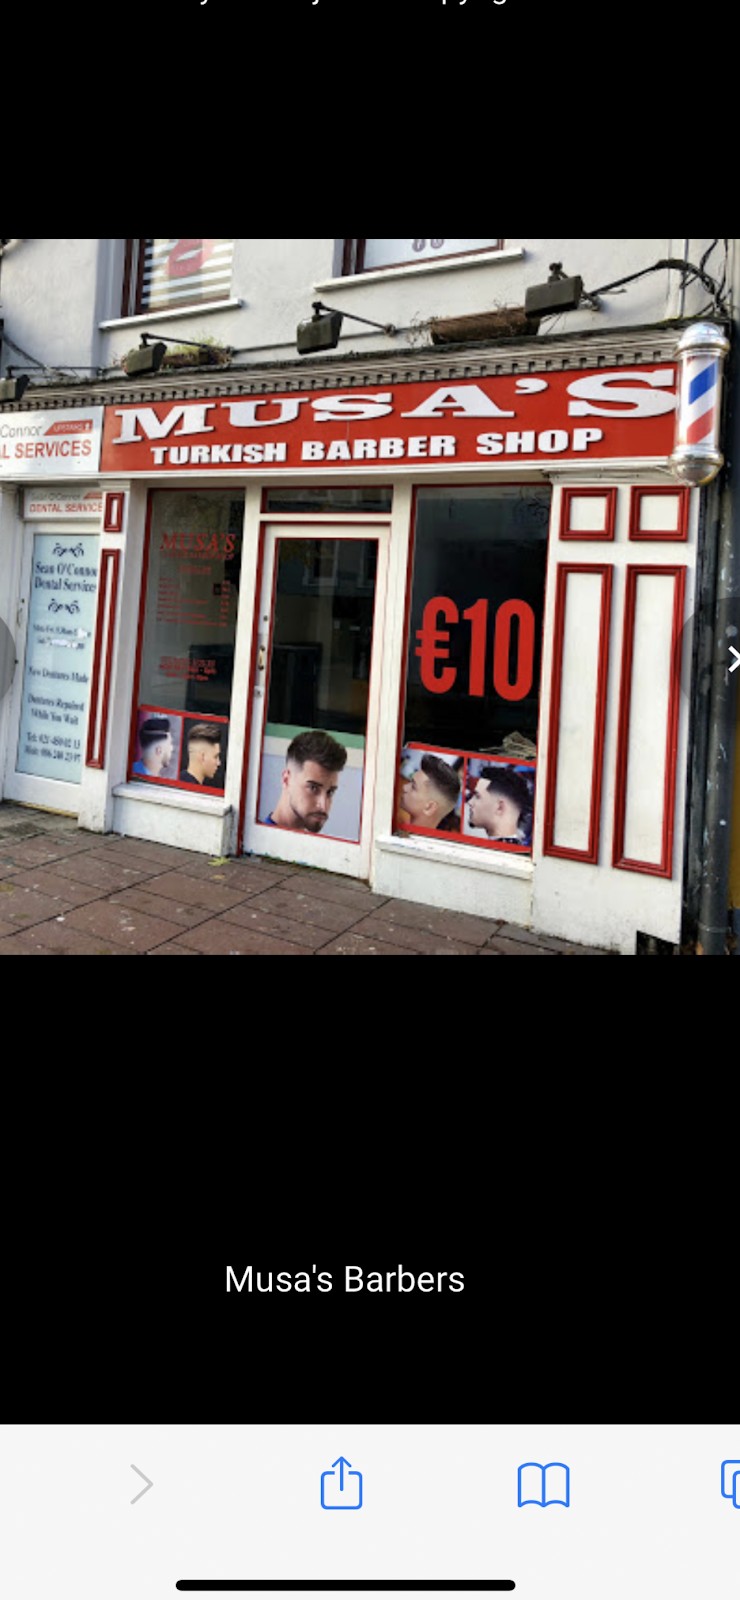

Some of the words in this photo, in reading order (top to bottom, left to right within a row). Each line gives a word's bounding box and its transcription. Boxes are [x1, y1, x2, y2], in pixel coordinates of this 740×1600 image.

[112, 368, 678, 444] MUSA'S
[15, 438, 92, 459] SERVICES
[151, 442, 288, 466] TURKISH
[301, 434, 457, 462] BARBER
[476, 427, 604, 457] SHOP
[30, 503, 62, 513] DENTAL
[160, 531, 236, 554] MUSA'S
[35, 561, 55, 574] Sean
[35, 576, 62, 590] Dental
[414, 596, 536, 702] €10
